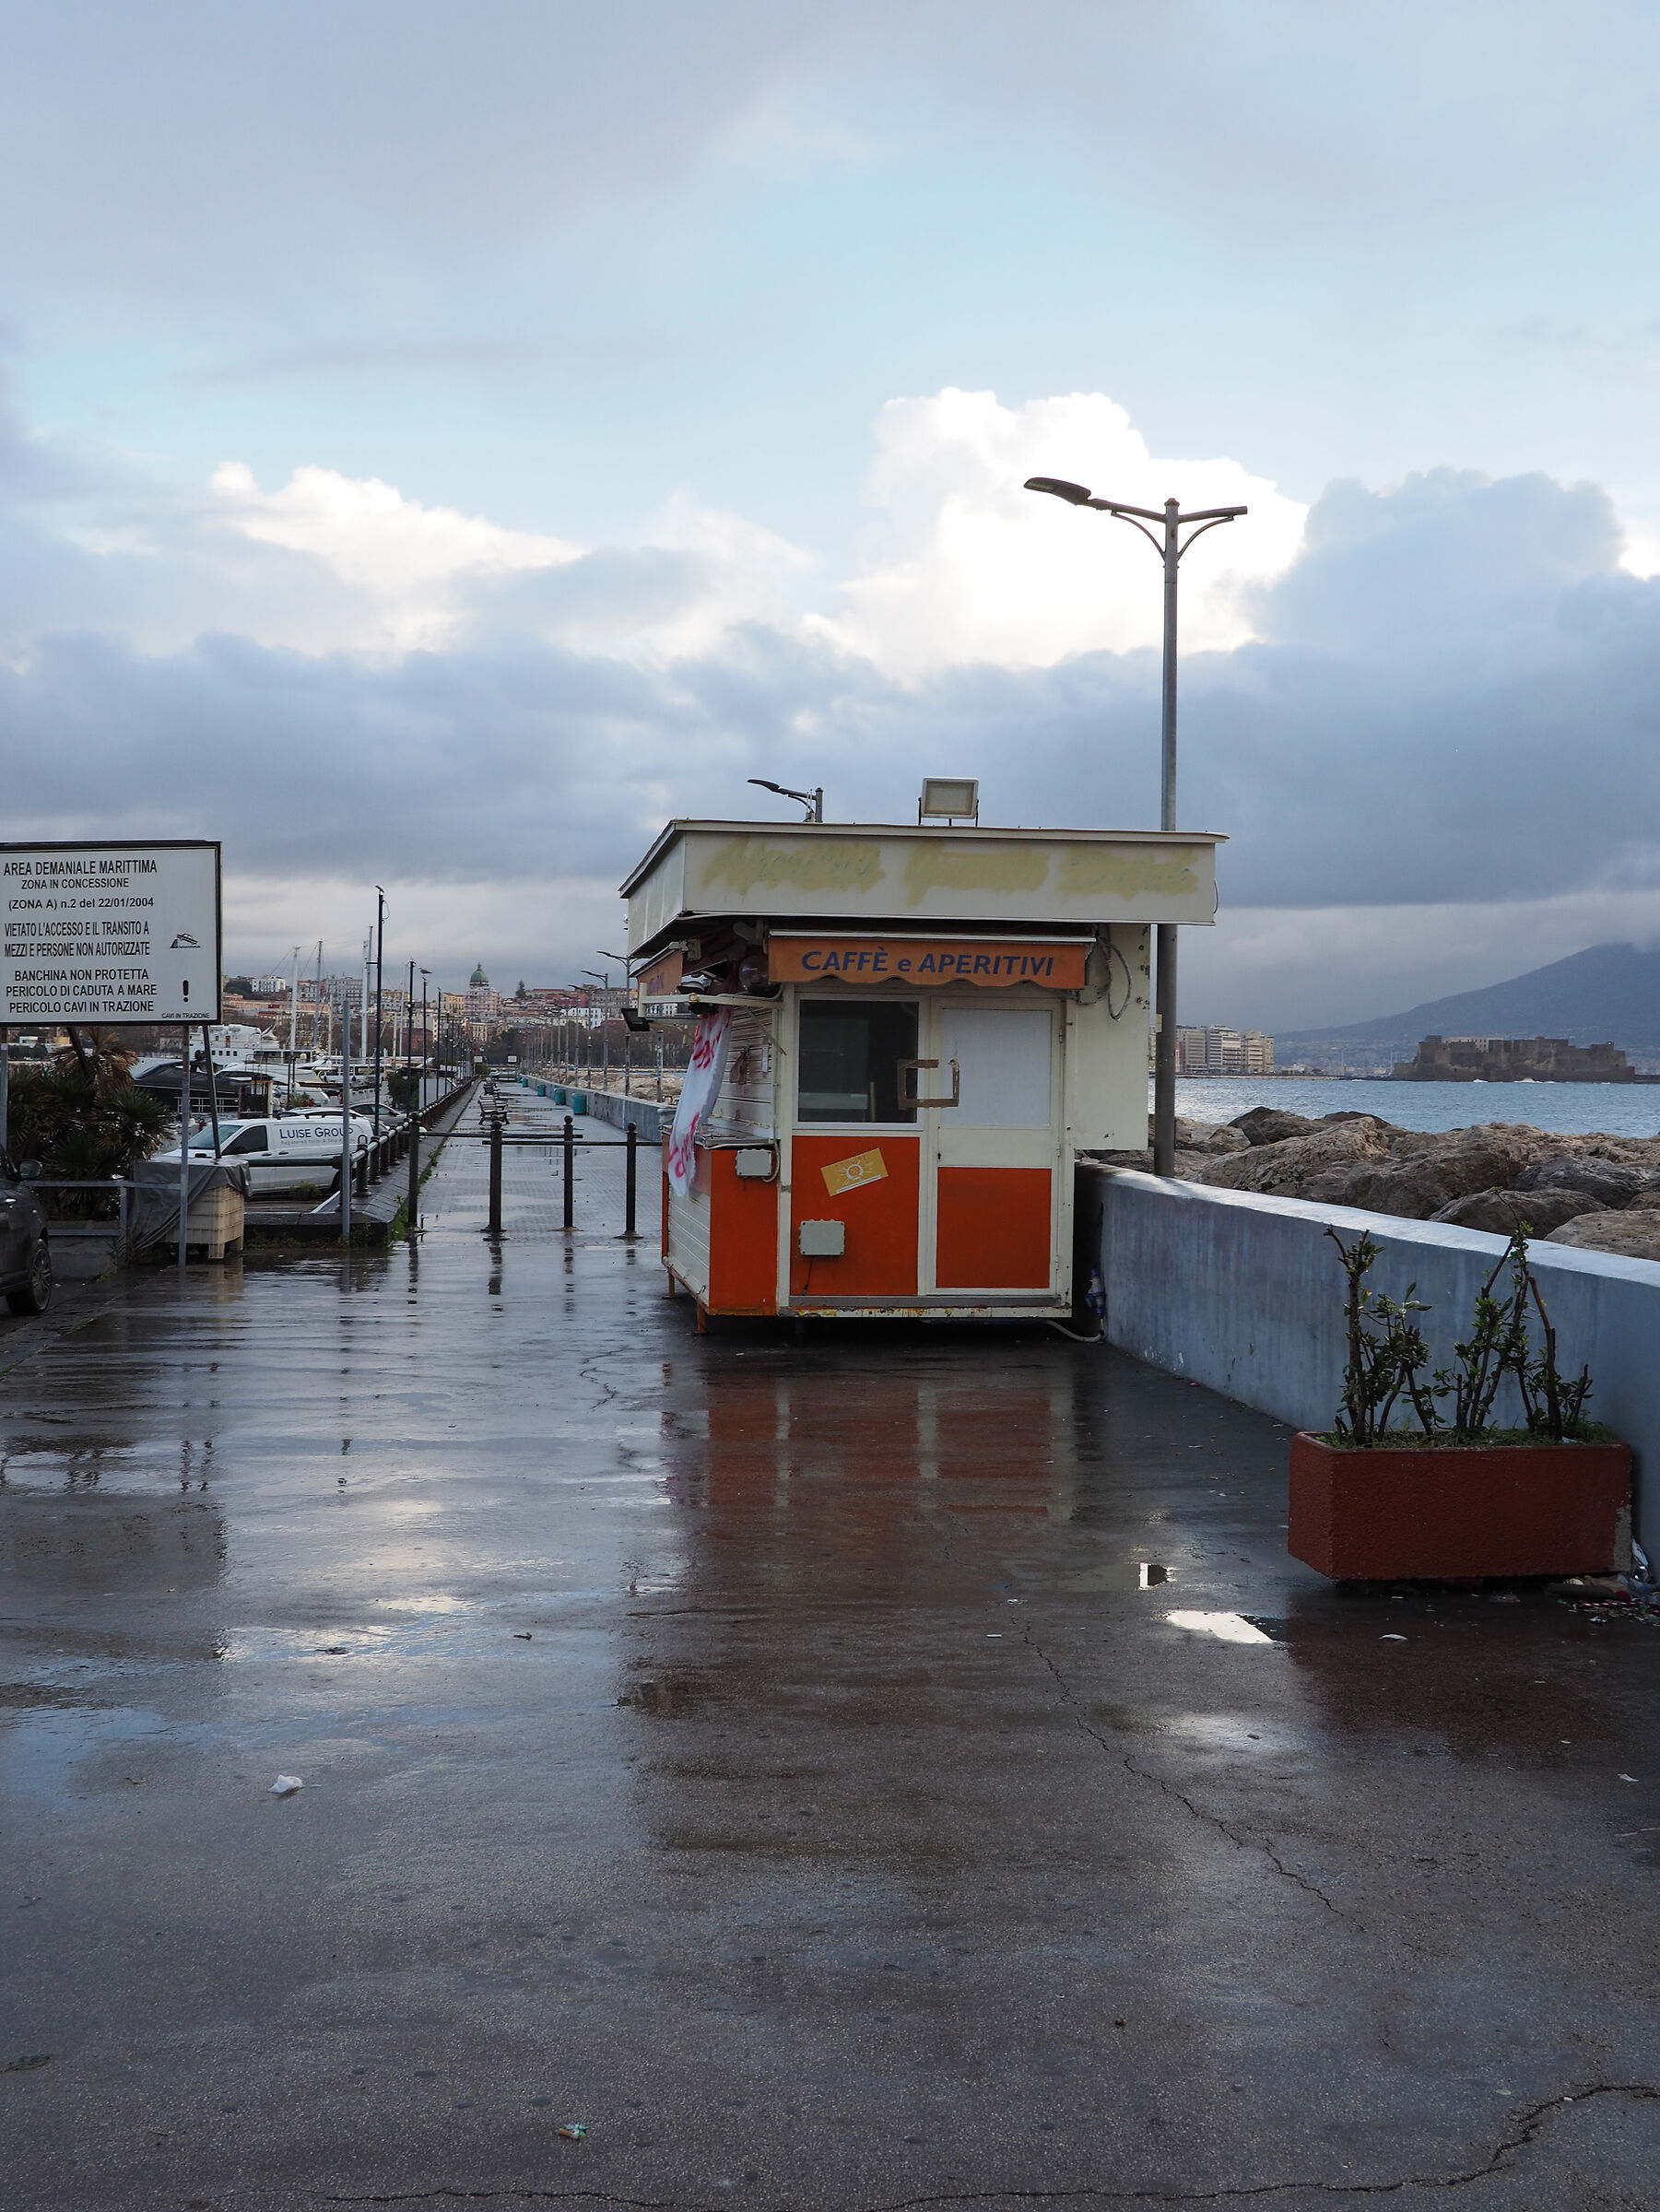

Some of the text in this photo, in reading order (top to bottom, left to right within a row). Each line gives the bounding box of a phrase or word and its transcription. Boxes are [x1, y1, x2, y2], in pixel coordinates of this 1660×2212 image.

[4, 859, 157, 876] AREA DEMANIALE MARITTIMA
[21, 877, 129, 889] ZONA IN CONCESSIONE
[8, 897, 154, 912] (ZONA A) n.2 del 22/01/2004
[5, 921, 149, 936] VIETATO L'ACCESSO E IL TRANSITO A
[5, 941, 150, 958] MEZZI E PERSONE NON AUTORIZZATE
[802, 947, 1054, 977] CAFFÈ e APERITIVI
[15, 969, 149, 982] BANCHINA NON PROTETTA
[6, 983, 158, 997] PERICOLO DI CADUTA A MARE
[9, 1001, 154, 1014] PERICOLO CAVI IN TRAZIONE
[279, 1128, 312, 1139] LUISE
